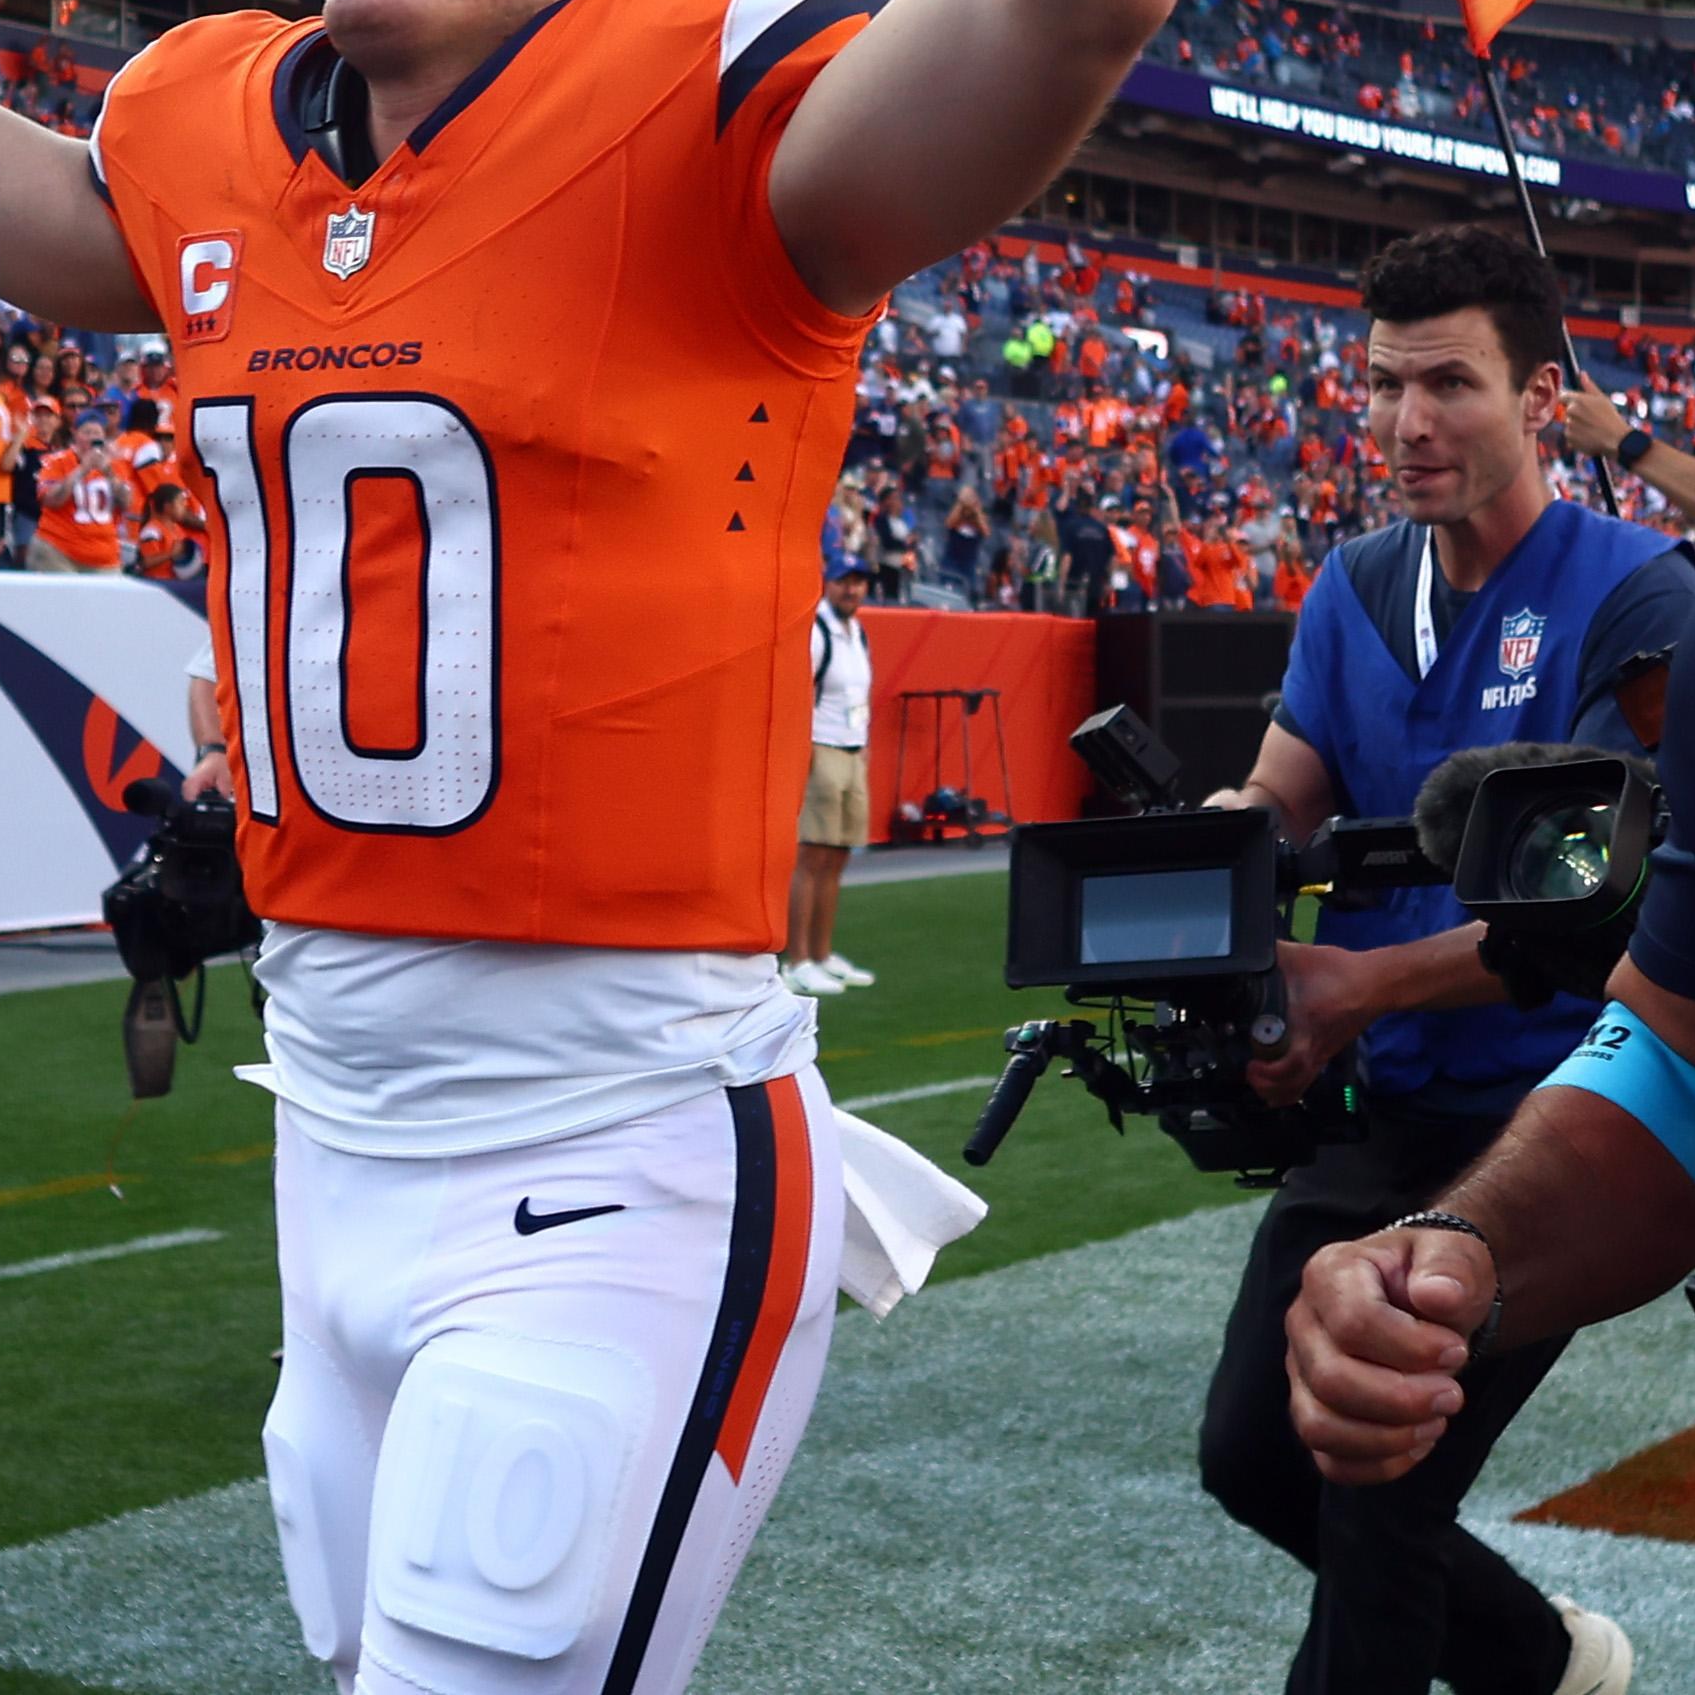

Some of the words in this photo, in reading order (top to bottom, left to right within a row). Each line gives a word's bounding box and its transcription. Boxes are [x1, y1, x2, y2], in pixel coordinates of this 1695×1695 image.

[1210, 84, 1260, 124] WE'LL
[1260, 97, 1301, 132] HELP
[1302, 107, 1335, 141] YOU
[1336, 114, 1381, 150] BUILD
[1381, 123, 1435, 162] YOURS
[1434, 135, 1454, 165] AT
[178, 239, 235, 315] C
[331, 239, 360, 266] NFL
[247, 341, 423, 373] BRONCOS
[72, 478, 112, 525] 10
[191, 392, 503, 838] 10
[1503, 638, 1538, 668] NFL
[407, 1394, 586, 1592] 10
